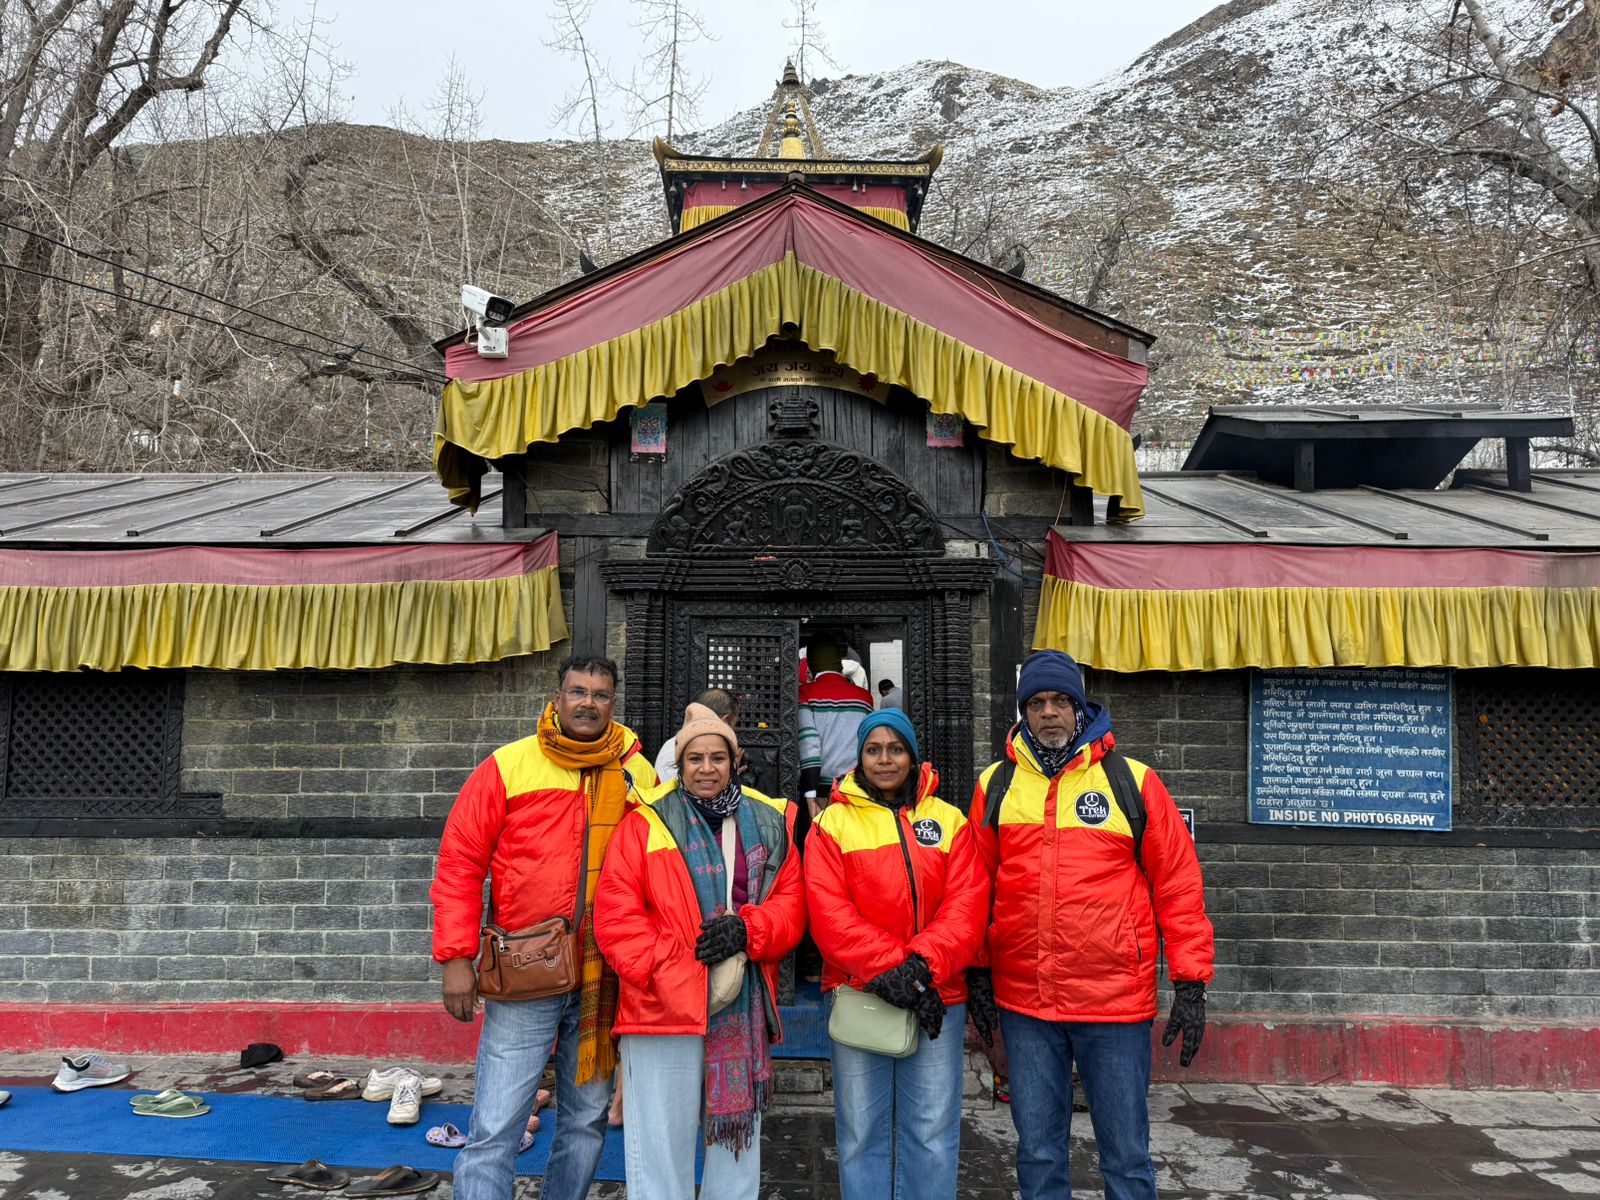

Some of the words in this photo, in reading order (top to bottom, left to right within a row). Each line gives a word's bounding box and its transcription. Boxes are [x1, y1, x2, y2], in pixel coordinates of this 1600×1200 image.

[1079, 805, 1107, 815] Trek
[1269, 809, 1317, 822] INSIDE
[1321, 811, 1340, 822] NO
[1343, 812, 1435, 826] PHOTOGRAPHY
[915, 828, 939, 839] Trek
